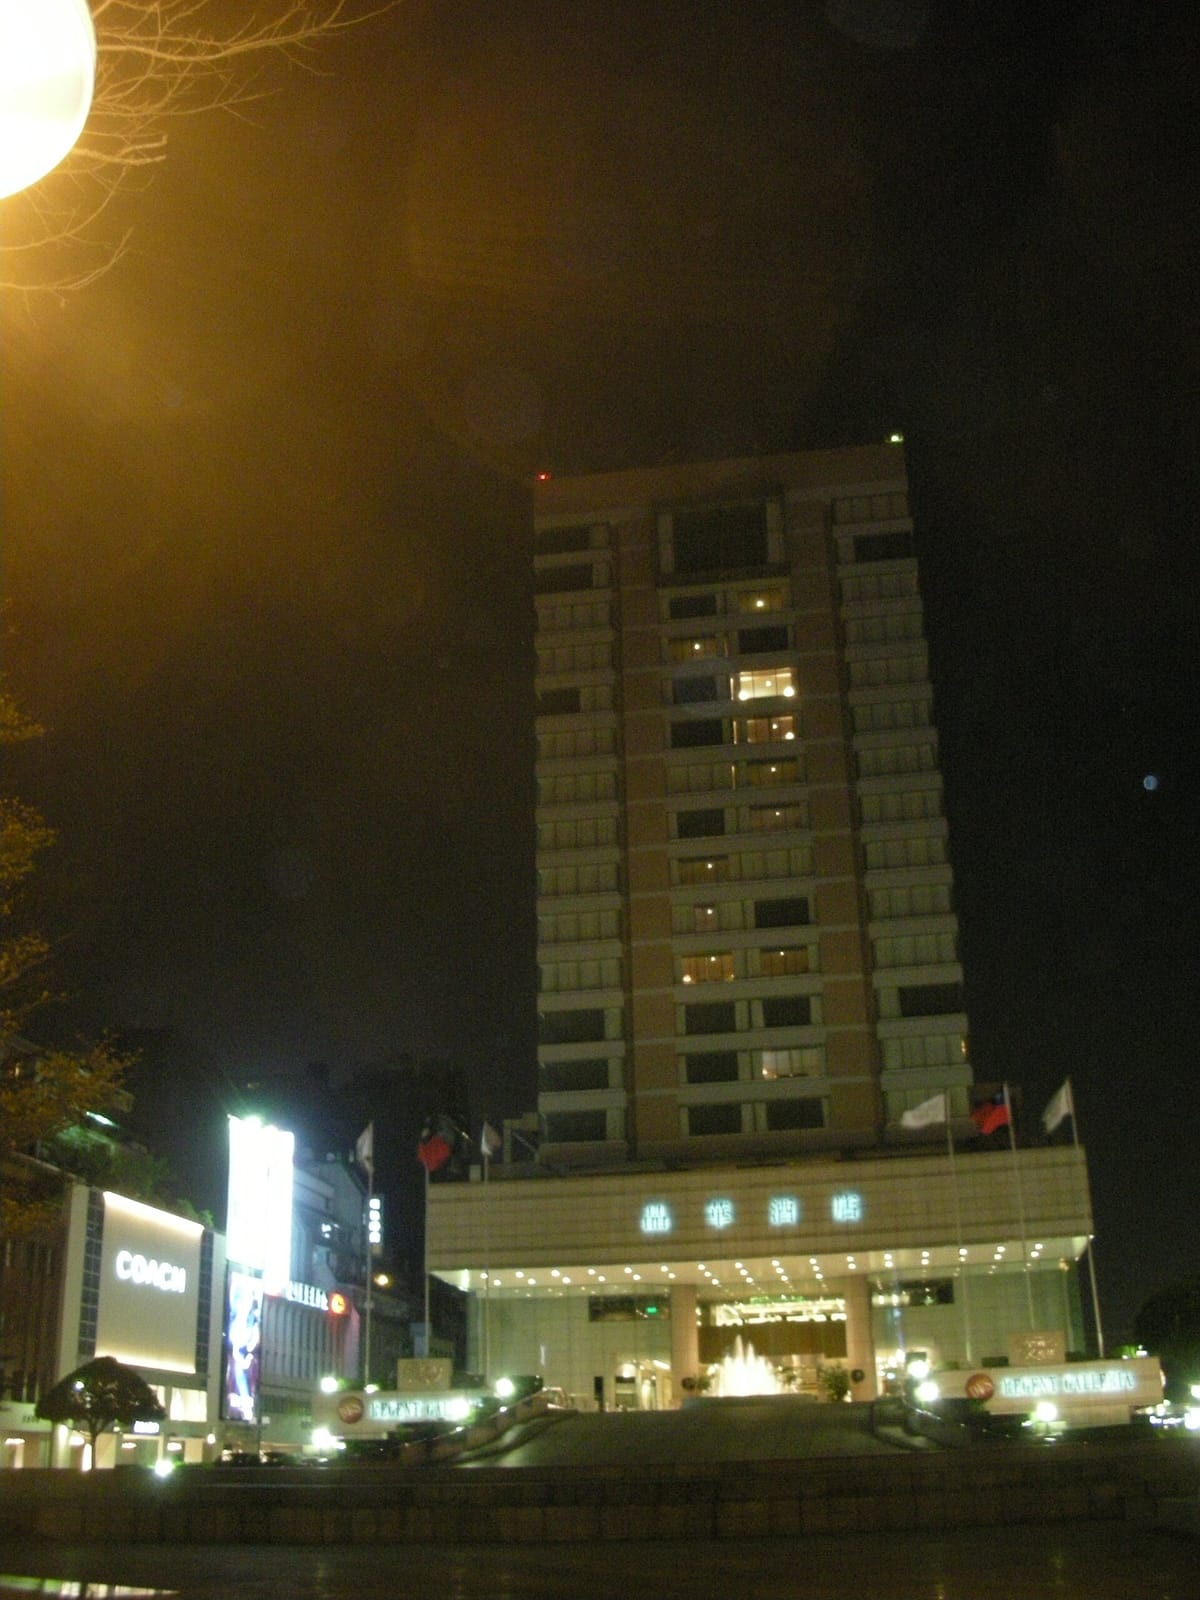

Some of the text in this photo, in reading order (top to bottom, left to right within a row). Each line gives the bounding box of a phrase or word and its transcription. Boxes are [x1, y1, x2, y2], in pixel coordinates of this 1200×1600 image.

[116, 1250, 186, 1292] COACH
[1002, 1376, 1058, 1396] REGENT
[1063, 1370, 1136, 1392] GALLERIA
